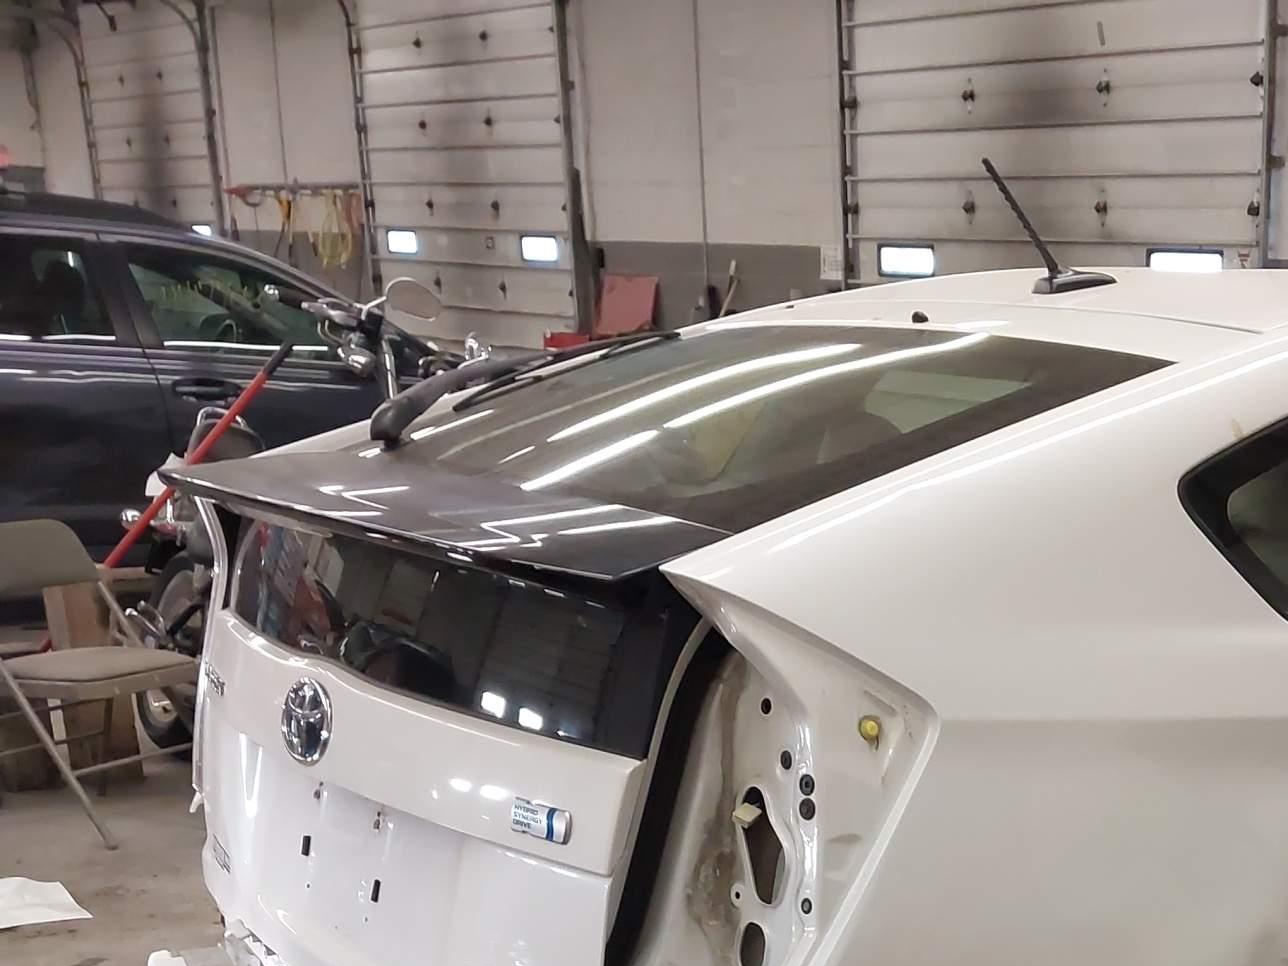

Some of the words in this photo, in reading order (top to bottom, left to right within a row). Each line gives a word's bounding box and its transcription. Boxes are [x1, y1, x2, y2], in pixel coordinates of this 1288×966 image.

[514, 804, 539, 816] HYBRID
[512, 818, 532, 829] DRIVE
[513, 811, 542, 824] SYNERGY
